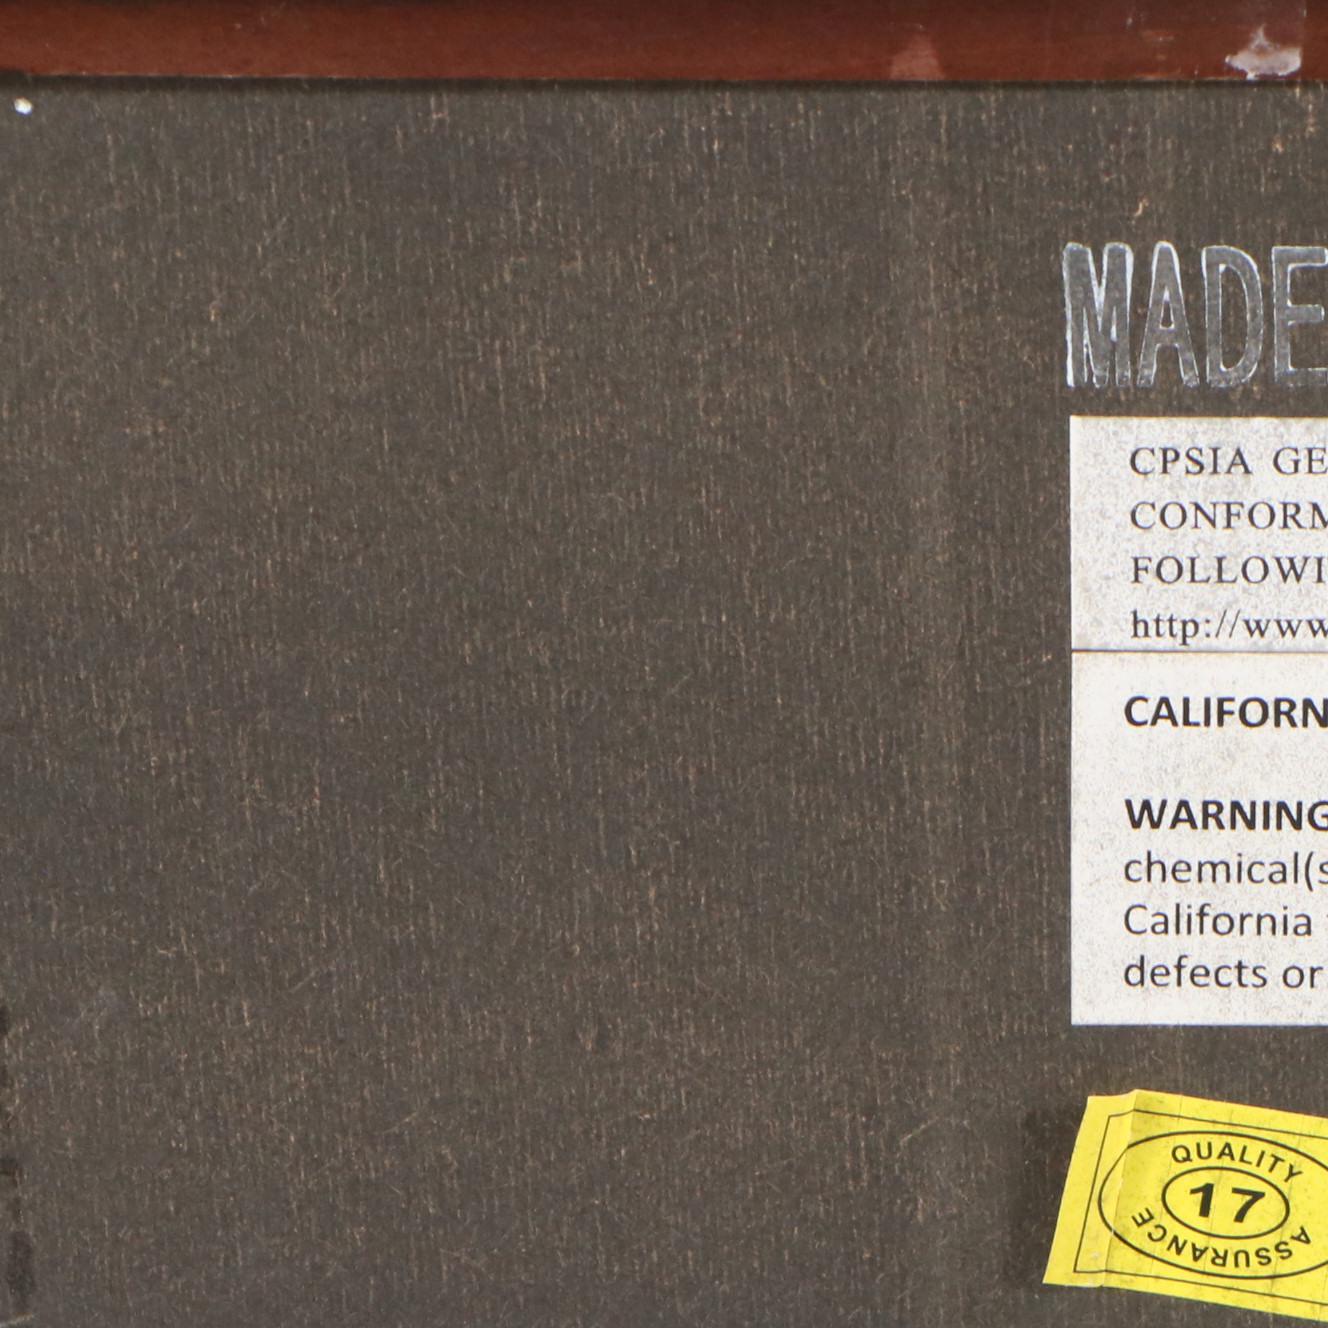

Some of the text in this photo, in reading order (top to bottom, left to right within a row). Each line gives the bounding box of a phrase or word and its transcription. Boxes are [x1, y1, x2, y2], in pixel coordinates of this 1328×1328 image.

[1129, 446, 1253, 477] CPSIA
[1123, 903, 1313, 937] California
[1123, 956, 1269, 990] defects
[1281, 965, 1325, 991] or
[1171, 1141, 1303, 1183] QUALITY
[1188, 1182, 1266, 1224] 17
[1131, 1206, 1313, 1268] ASSURANCE
